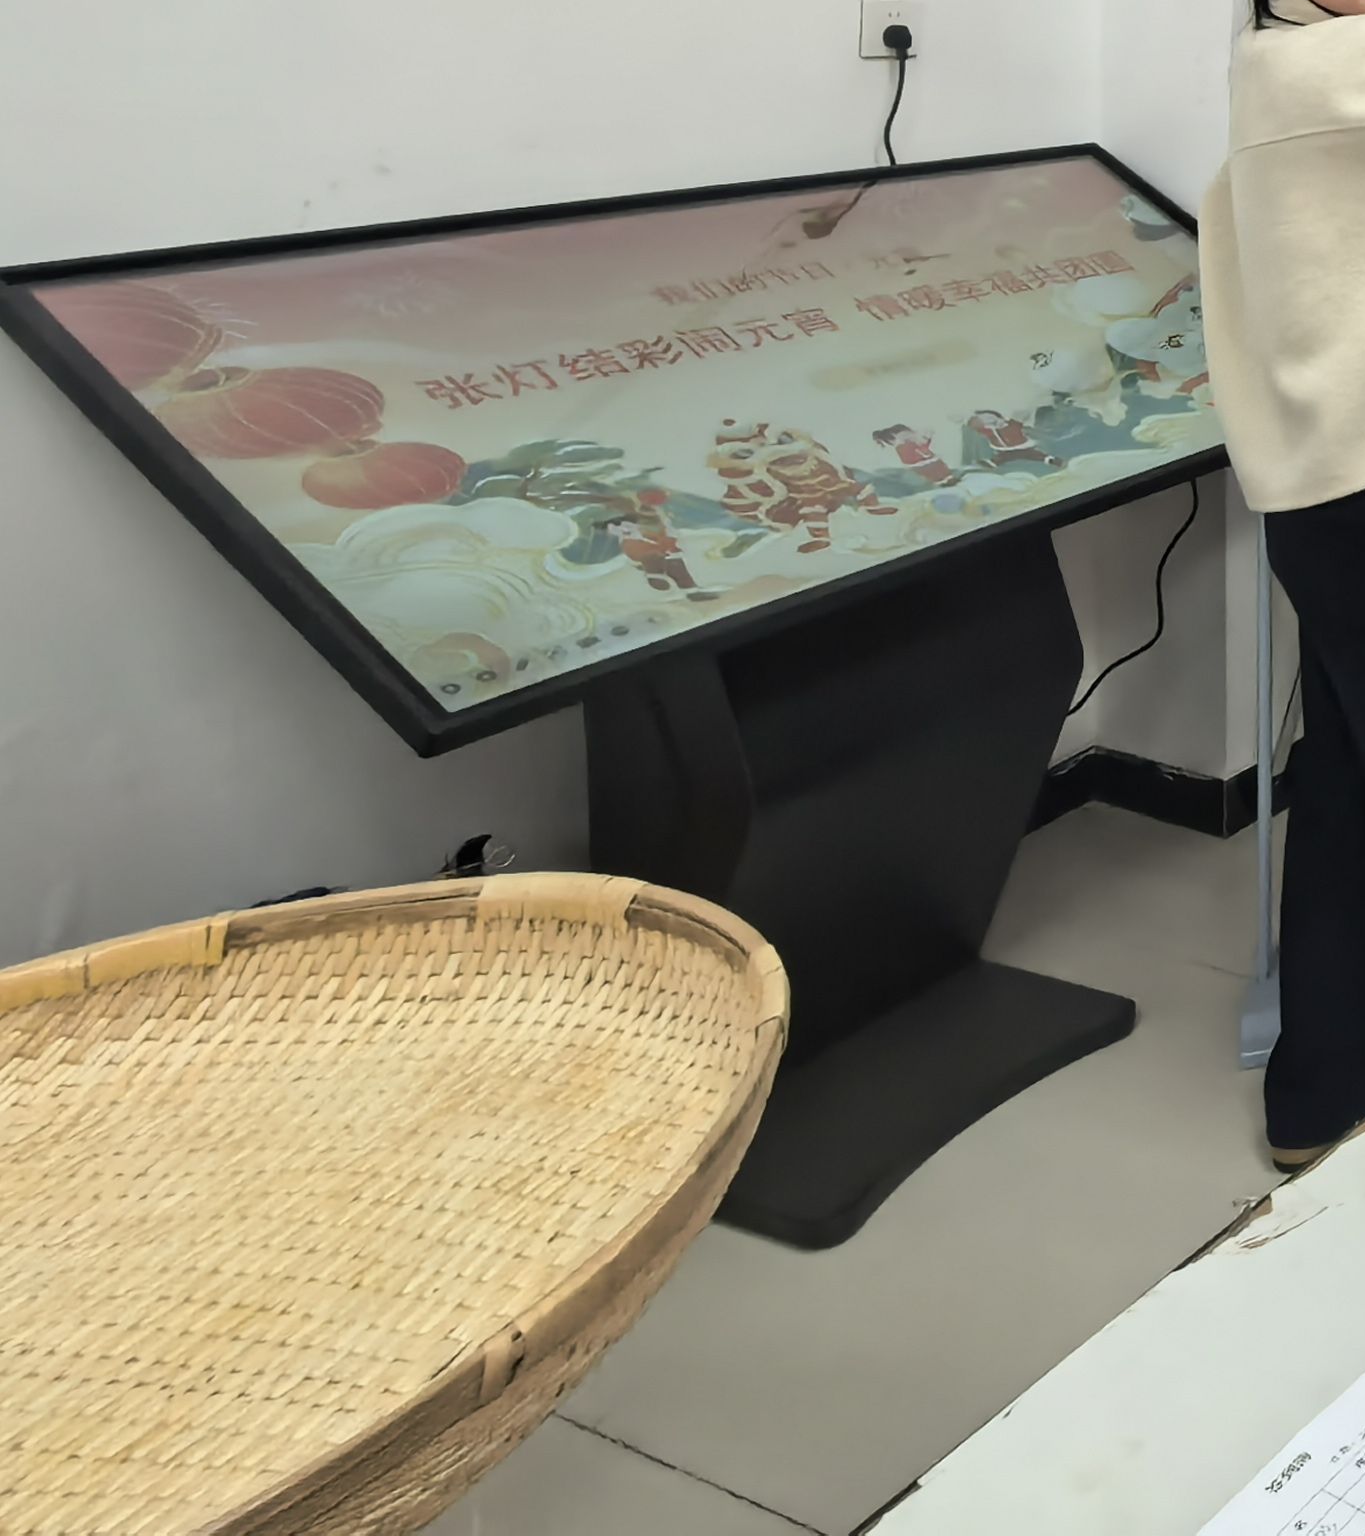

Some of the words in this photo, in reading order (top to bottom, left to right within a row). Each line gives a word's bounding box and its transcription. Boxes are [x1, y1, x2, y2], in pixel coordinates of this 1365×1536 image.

[414, 307, 840, 410] 张灯结彩闹元宵
[853, 249, 1137, 322] 情暖幸福共团圆
